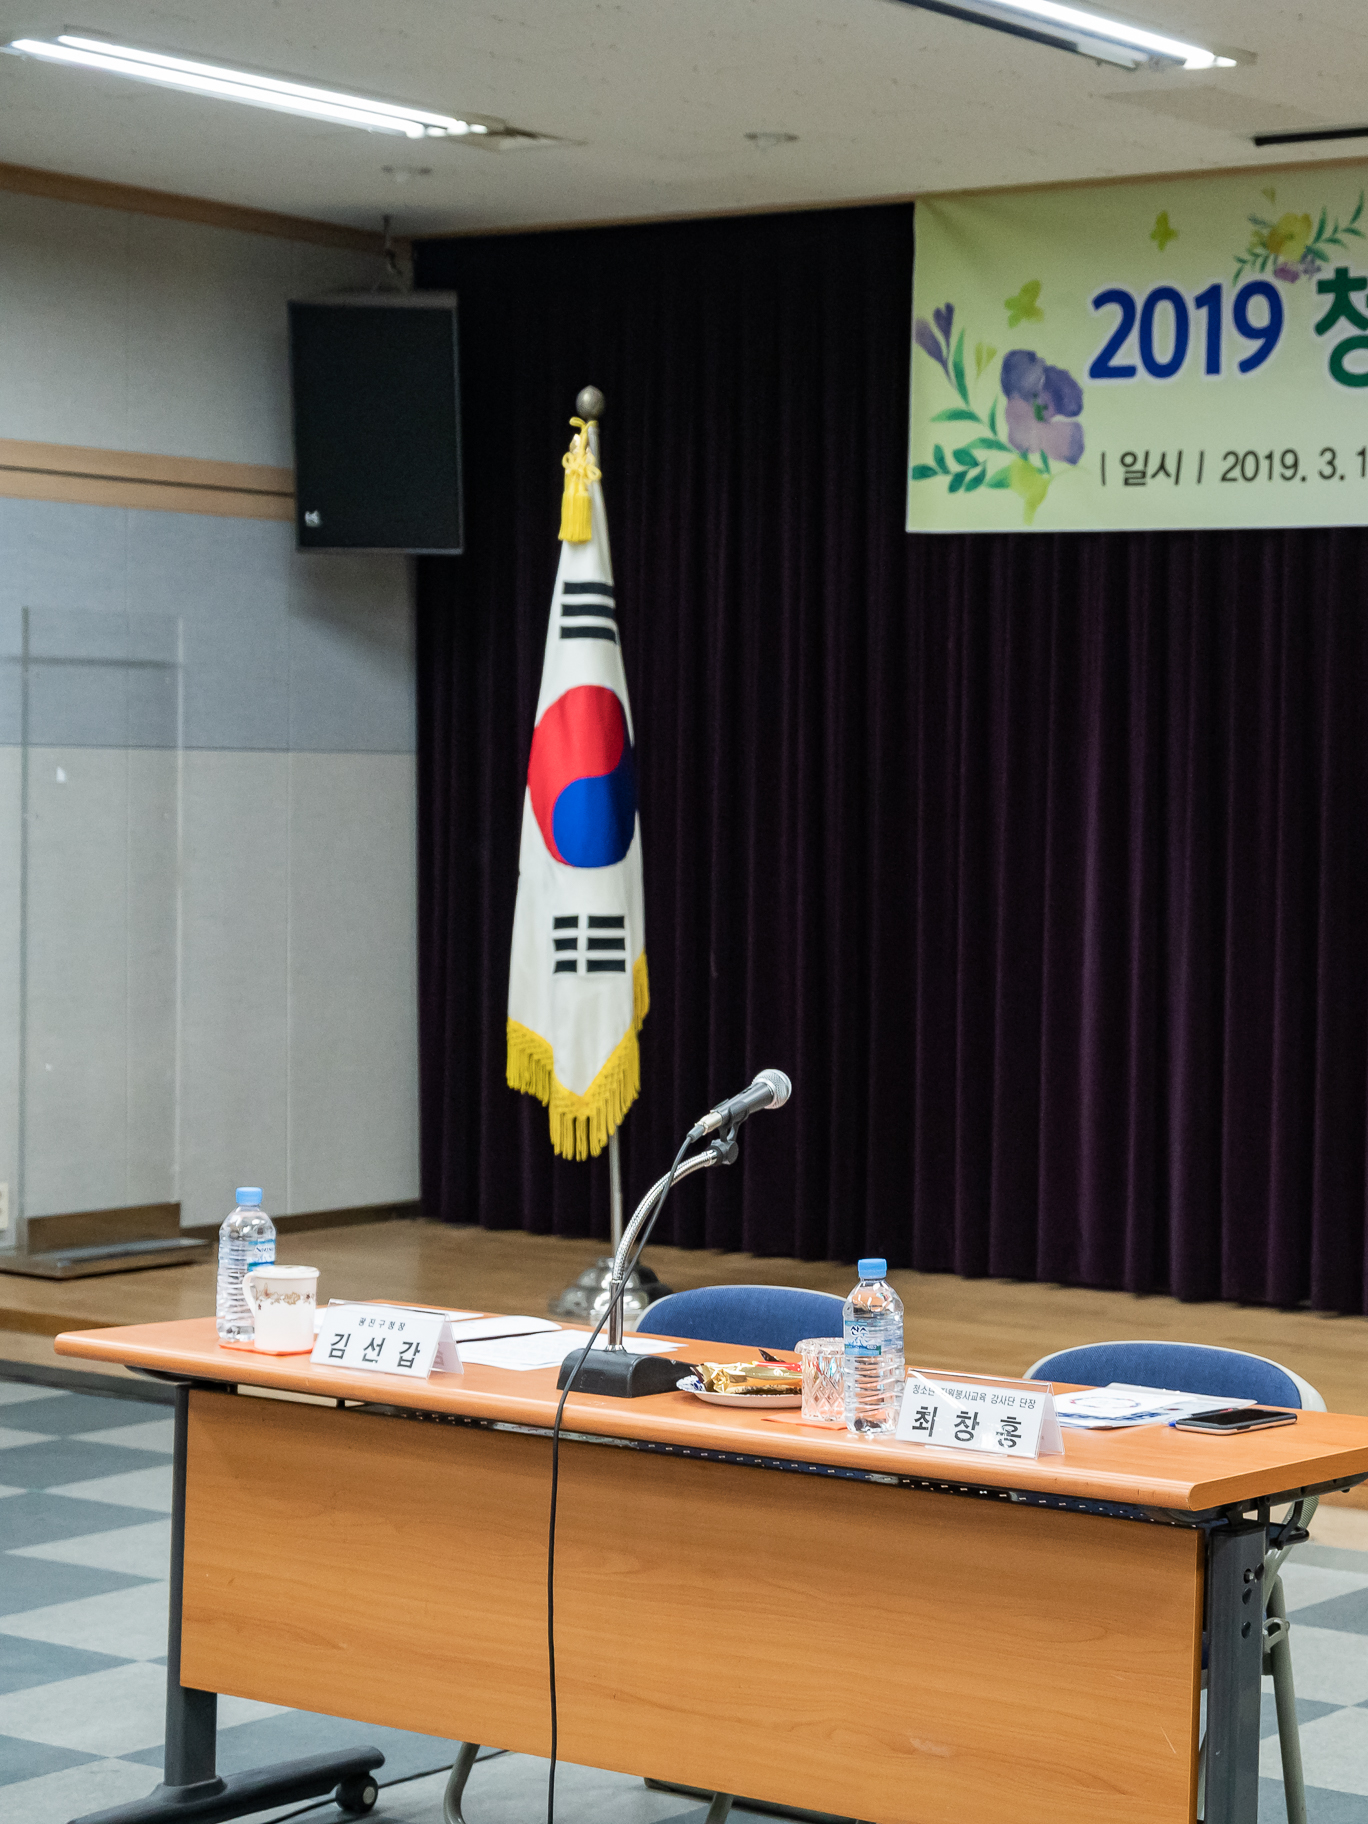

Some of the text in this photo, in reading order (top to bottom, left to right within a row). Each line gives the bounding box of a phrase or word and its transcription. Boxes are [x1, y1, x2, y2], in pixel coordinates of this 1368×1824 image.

[1088, 279, 1285, 380] 2019
[990, 1394, 1016, 1407] 강사단
[1019, 1398, 1037, 1410] 단장
